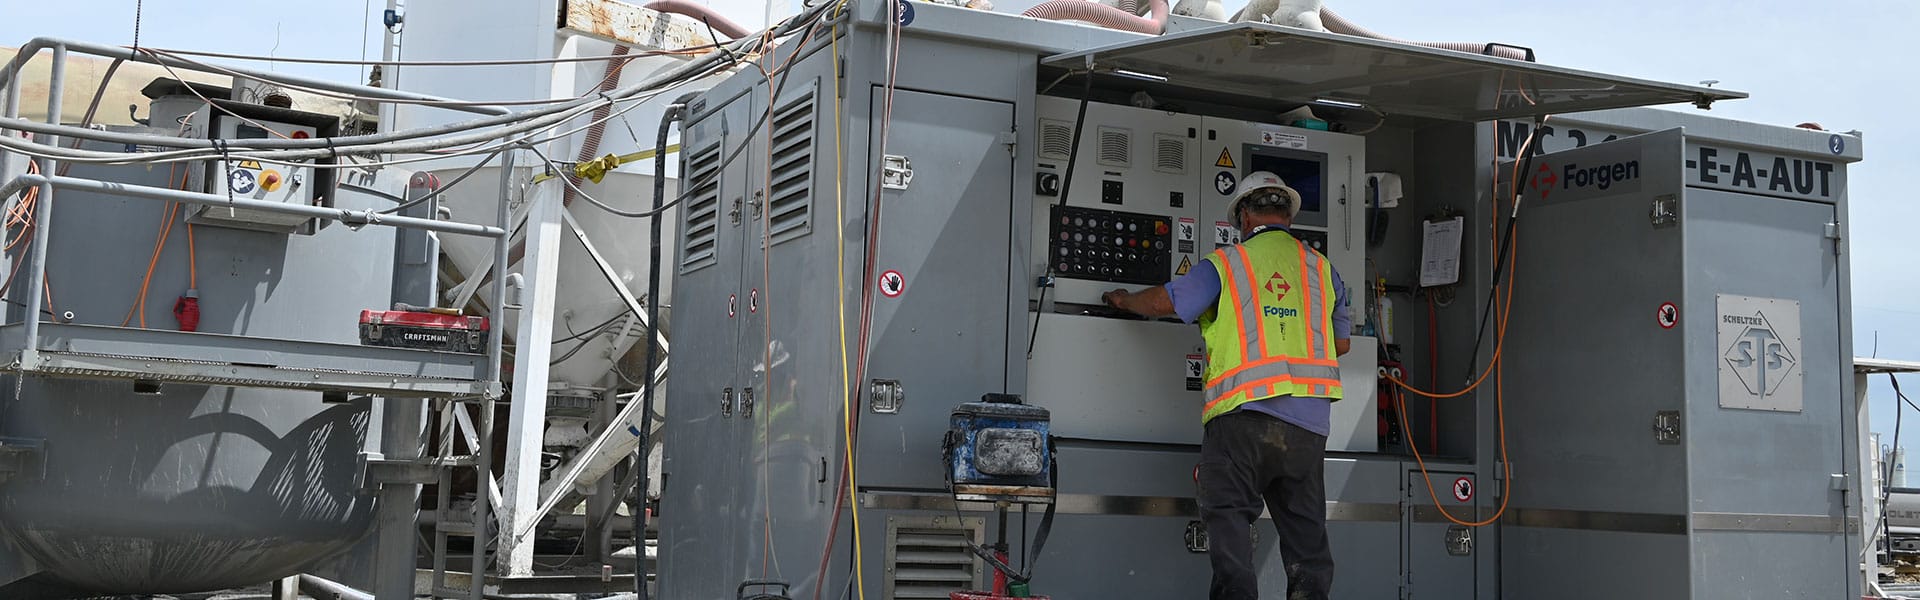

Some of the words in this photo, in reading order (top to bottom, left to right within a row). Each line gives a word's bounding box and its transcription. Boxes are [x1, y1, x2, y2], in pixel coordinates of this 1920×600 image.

[1563, 160, 1639, 190] Forgen
[1723, 315, 1763, 326] SCHELTZKE
[404, 333, 447, 342] CRAFTSMAN
